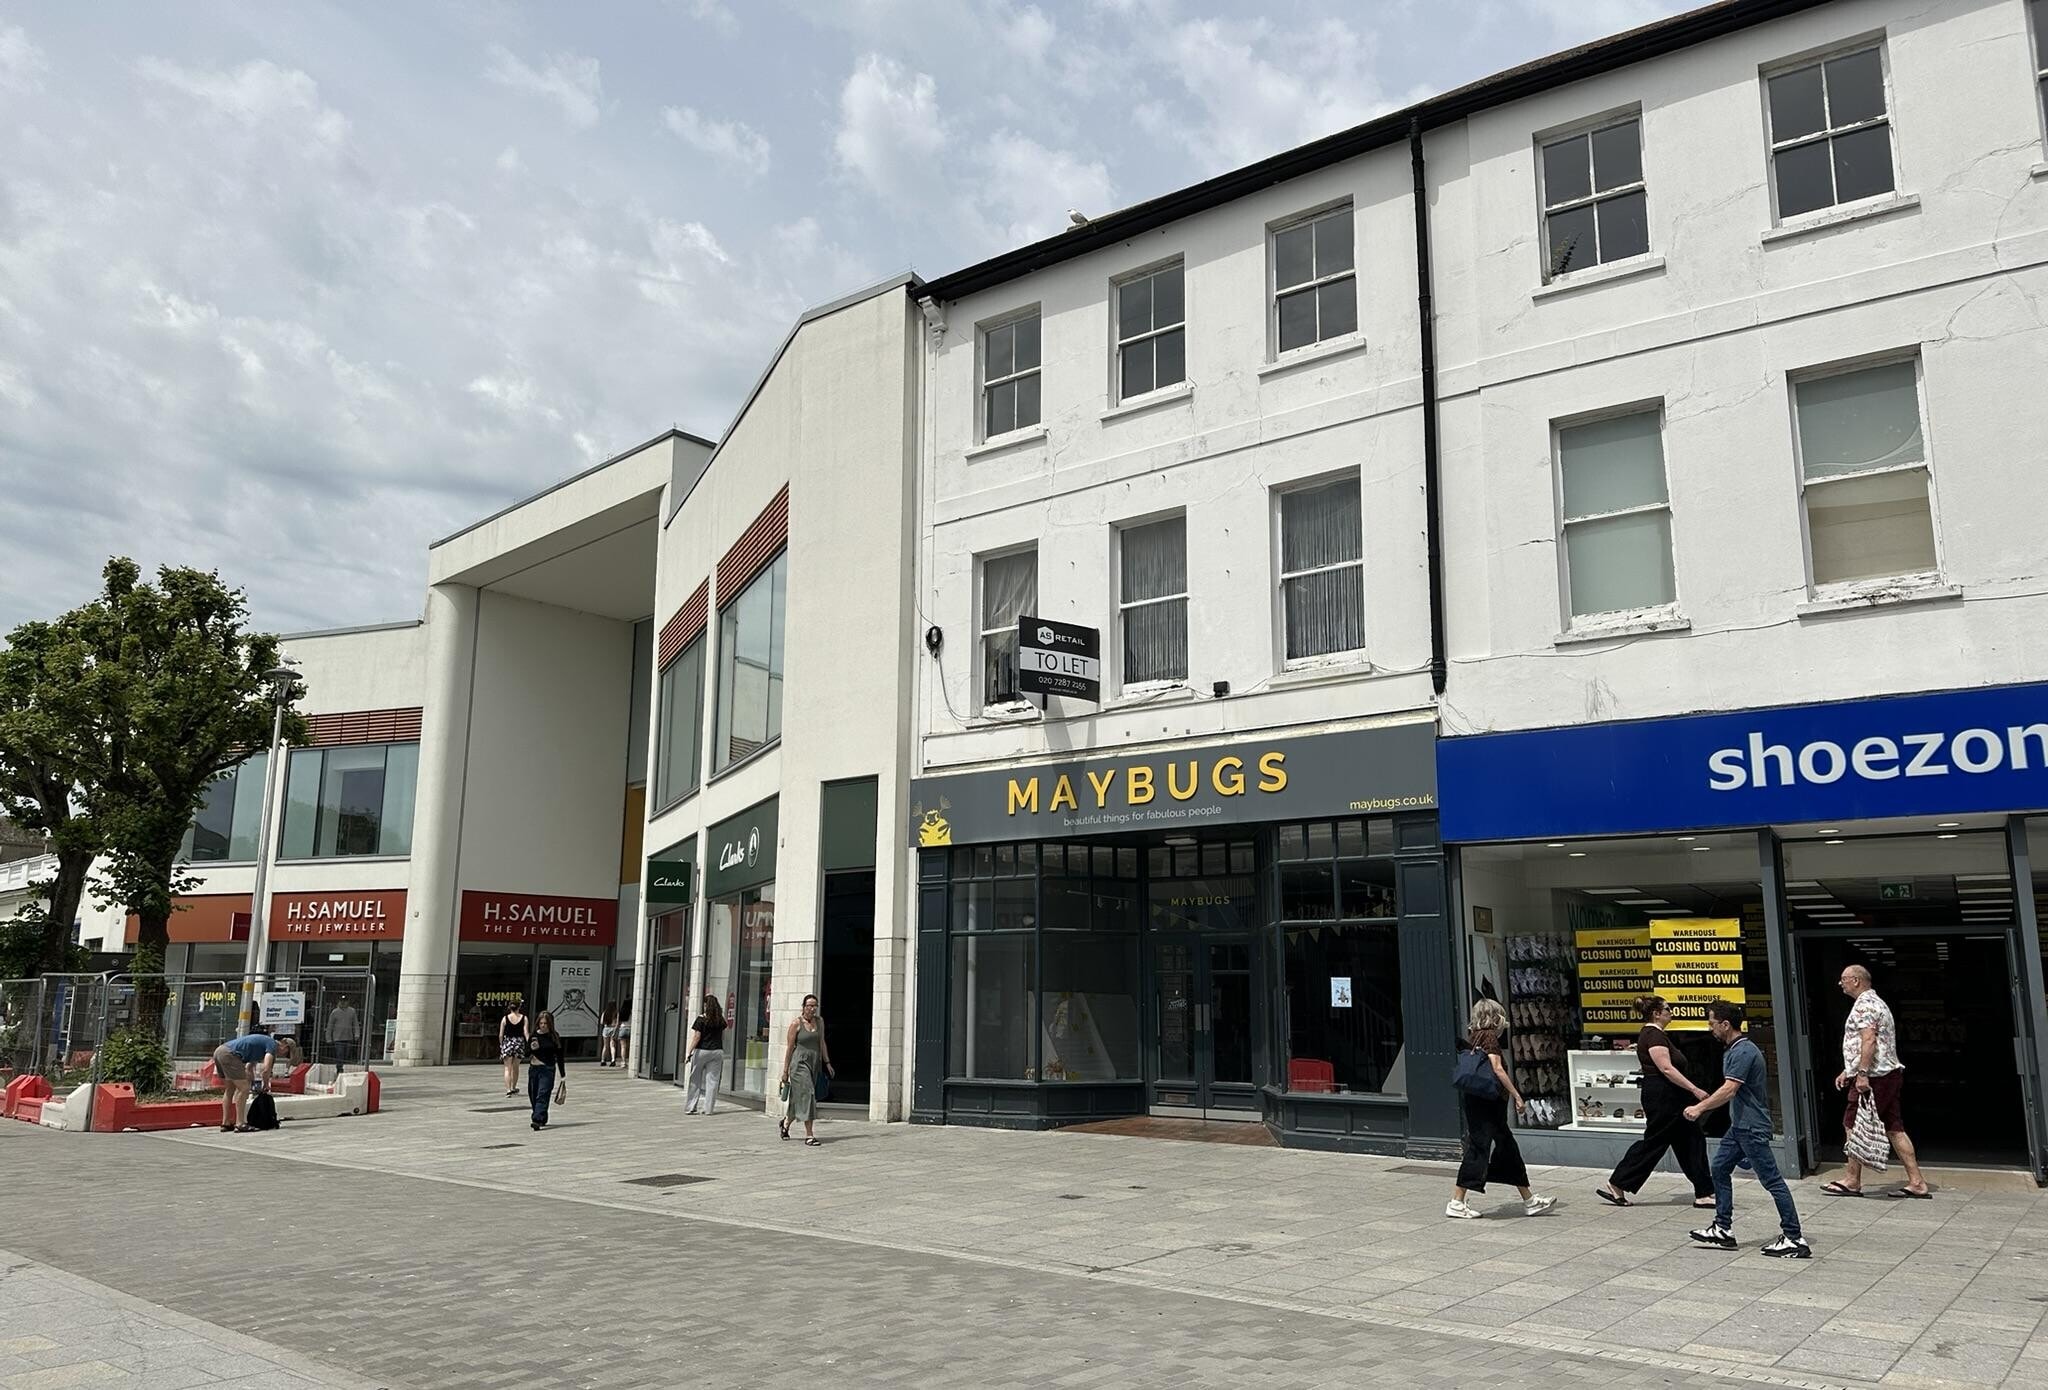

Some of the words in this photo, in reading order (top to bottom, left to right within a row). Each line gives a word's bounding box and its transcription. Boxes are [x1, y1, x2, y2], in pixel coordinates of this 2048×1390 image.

[1040, 631, 1052, 640] AS
[1055, 634, 1085, 646] RETAIL
[1034, 651, 1058, 671] TO
[1063, 656, 1088, 675] LET
[1038, 676, 1052, 685] 020
[1054, 678, 1071, 688] 7287
[1708, 723, 2048, 791] shoezon
[1007, 752, 1289, 815] MAYBUGS
[1349, 793, 1434, 811] maybugs.co.uk
[1063, 813, 1102, 827] beautiful
[1103, 812, 1130, 825] things
[1132, 810, 1145, 822] for
[1146, 808, 1187, 820] fabulous
[1188, 804, 1222, 818] people
[719, 840, 745, 871] Clarks
[653, 877, 685, 887] Clarks
[1170, 896, 1231, 906] MAYBUGS
[287, 900, 386, 920] H.SAMUEL
[484, 902, 598, 925] H.SAMUEL
[287, 923, 312, 933] THE
[319, 922, 386, 934] JEWELLER
[484, 924, 513, 935] THE
[522, 926, 597, 937] JEWELLER
[1673, 929, 1717, 937] WAREHOUSE
[1596, 938, 1636, 946] WAREHOUSE
[1655, 941, 1701, 952] CLOSING
[1704, 941, 1737, 952] DOWN
[1581, 950, 1622, 960] CLOSING
[561, 967, 591, 977] FREE
[1598, 968, 1639, 976] WAREHOUSE
[1657, 973, 1703, 984] CLOSING
[1706, 973, 1739, 984] DOWN
[1583, 979, 1625, 990] CLOSING
[476, 991, 523, 1002] SUMMER
[1586, 1010, 1627, 1020] CLOSING
[1630, 1009, 1644, 1020] DO
